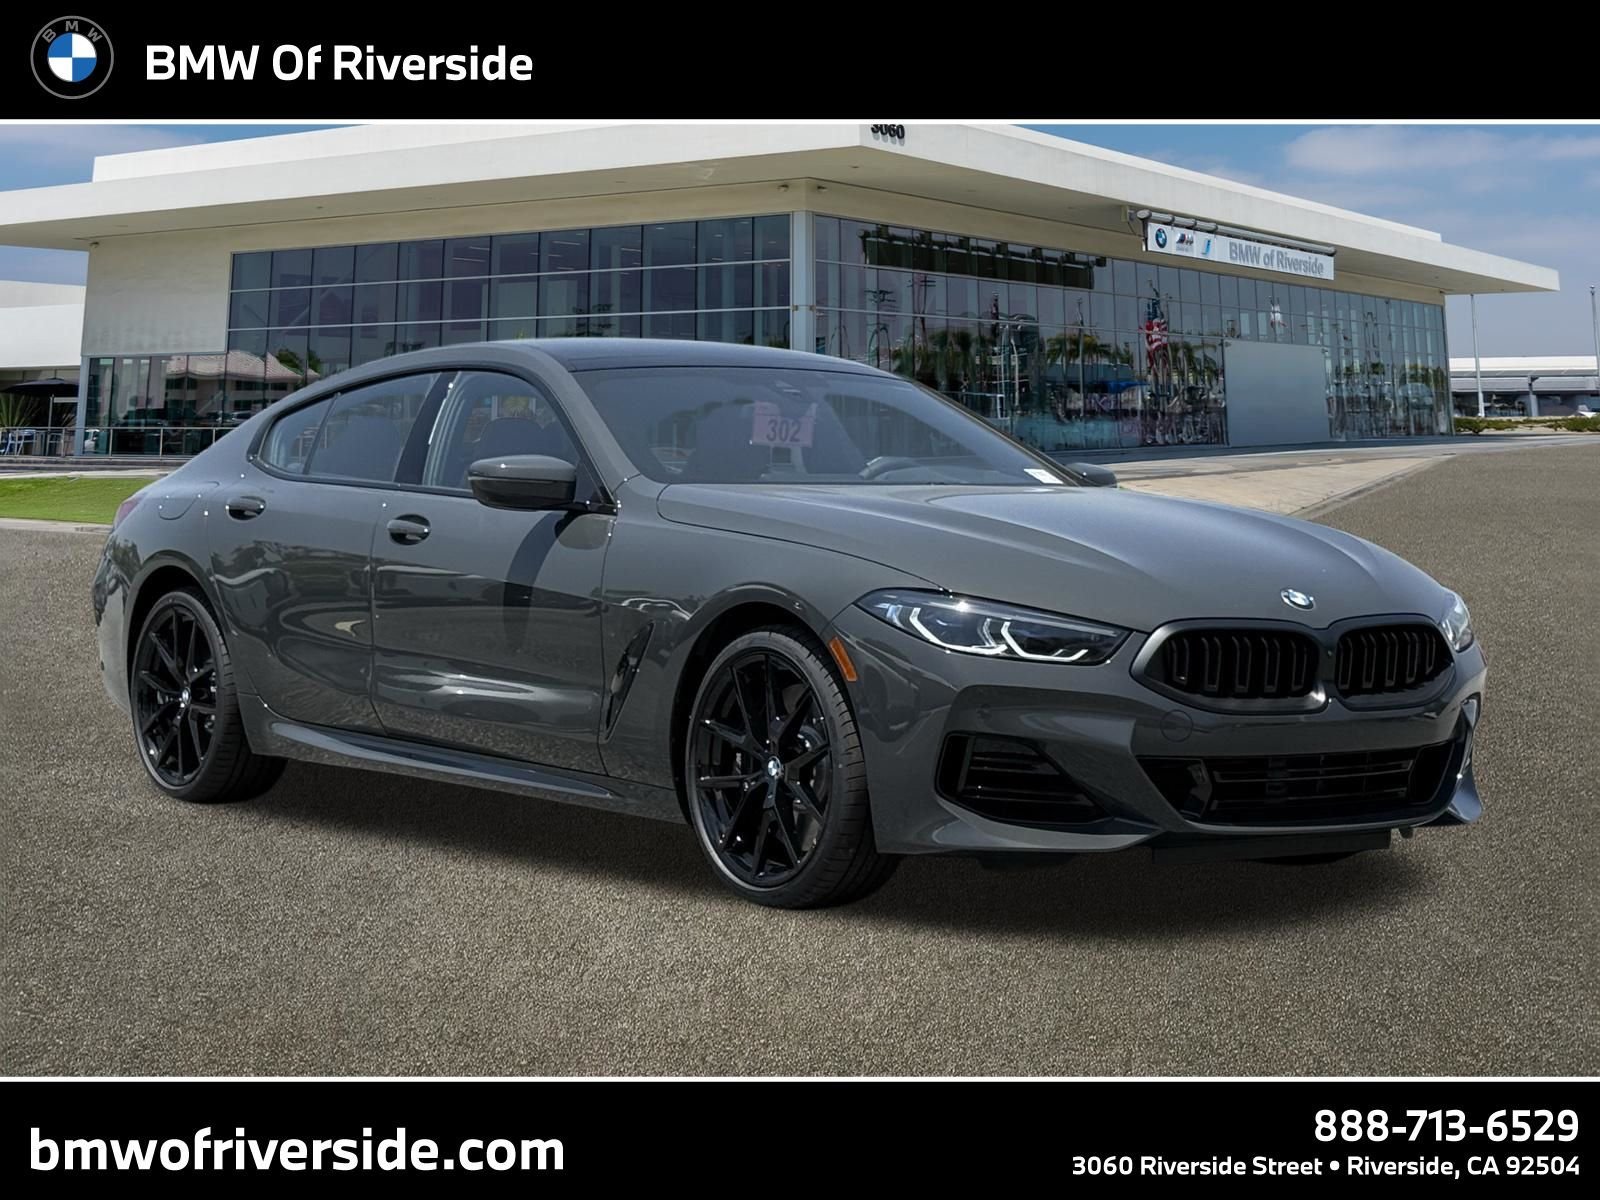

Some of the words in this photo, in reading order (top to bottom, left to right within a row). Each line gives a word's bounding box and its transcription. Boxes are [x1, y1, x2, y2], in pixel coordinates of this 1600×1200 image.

[1229, 241, 1261, 265] BMW
[1263, 249, 1275, 268] of
[1276, 250, 1324, 275] Riverside
[766, 419, 801, 442] 302
